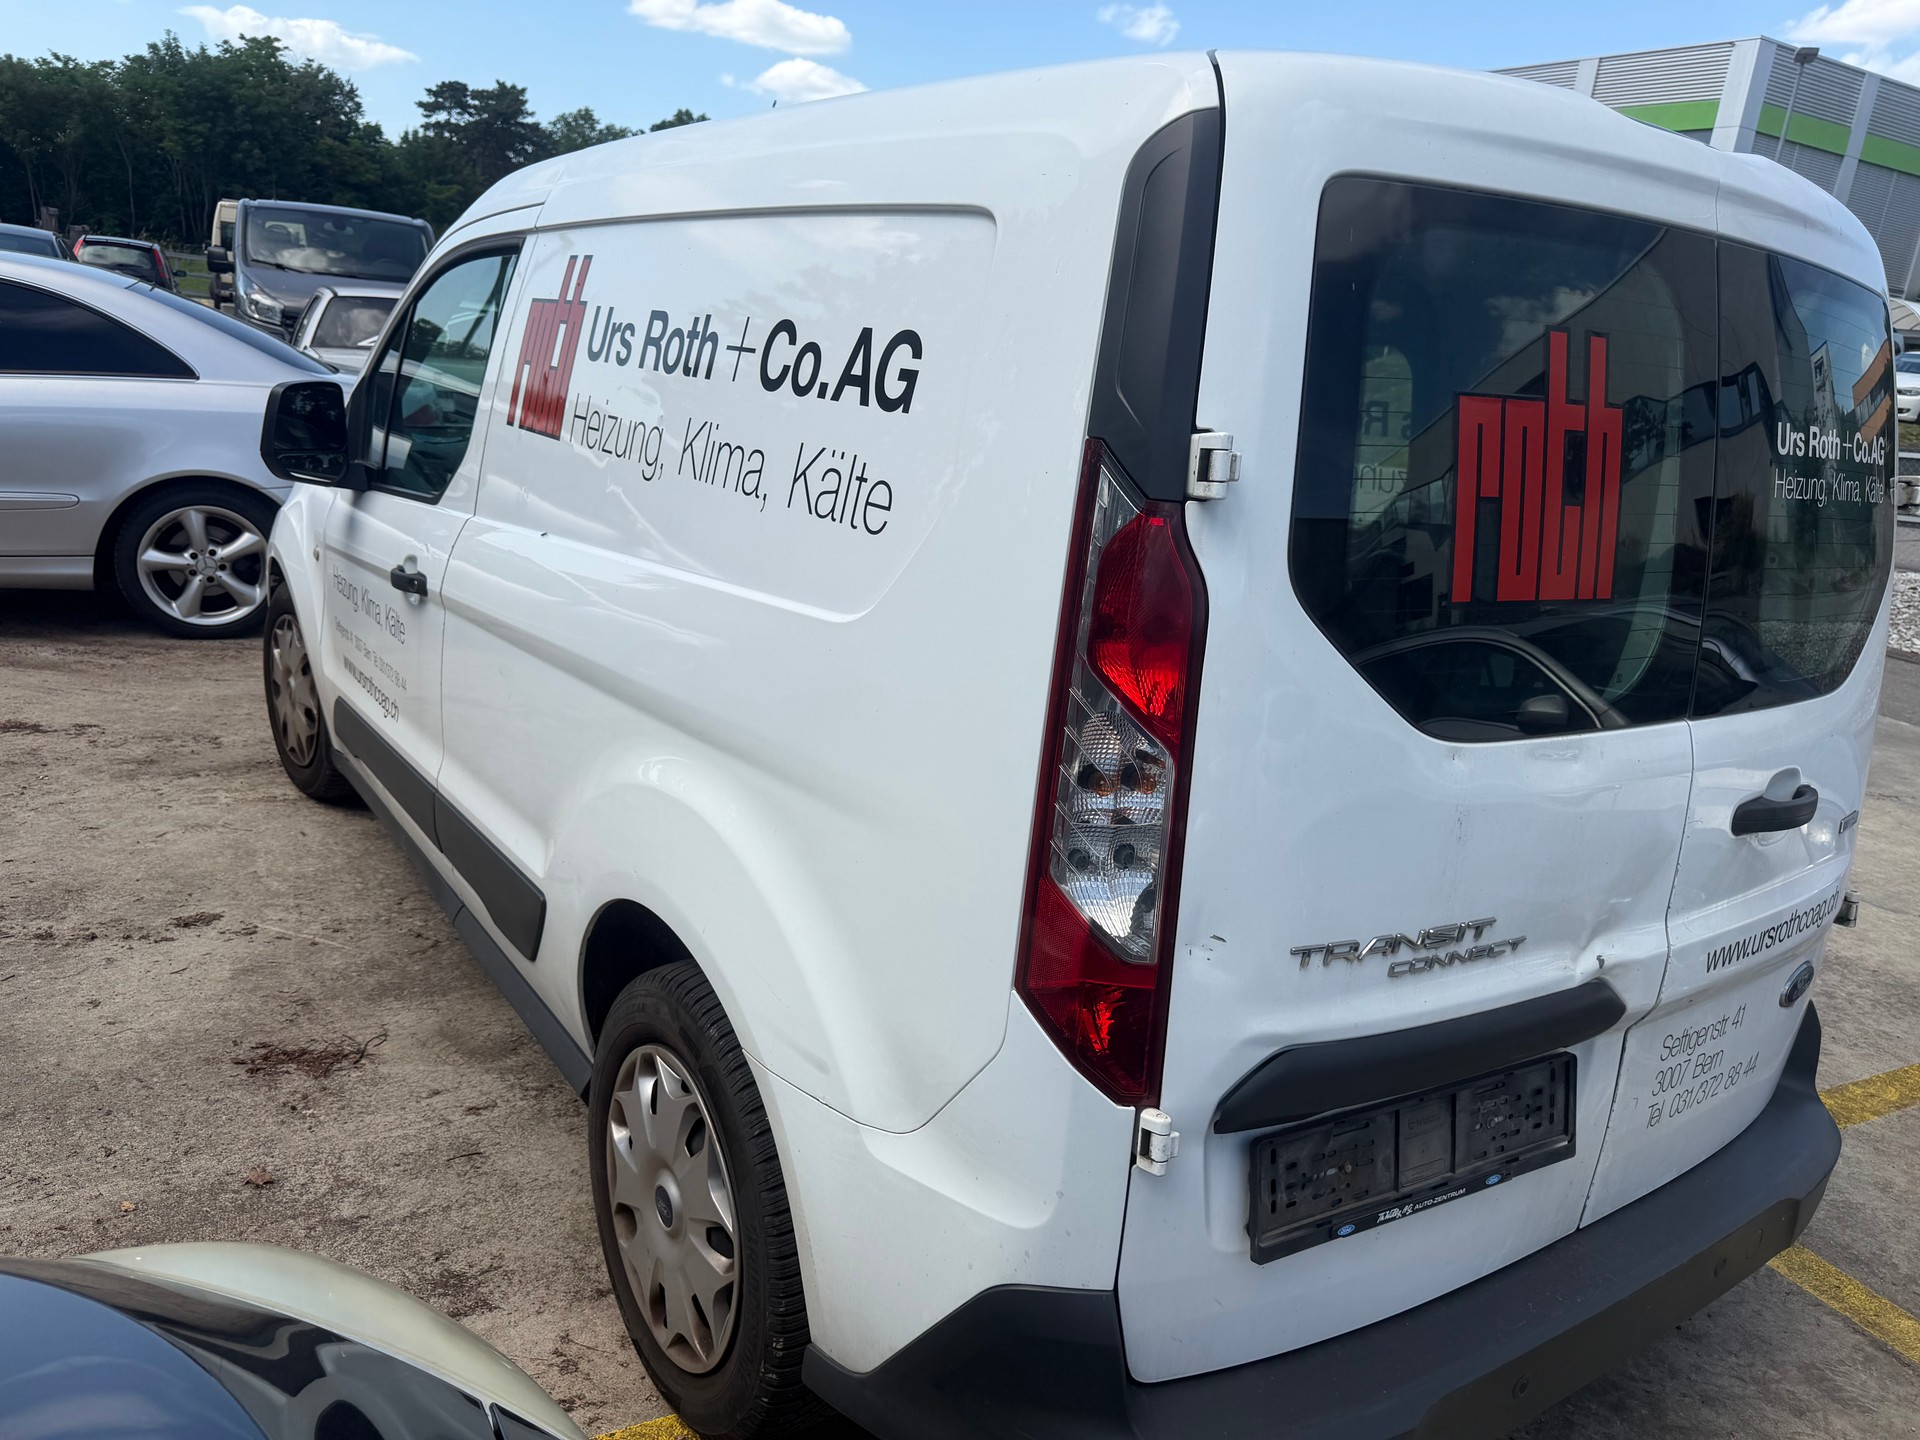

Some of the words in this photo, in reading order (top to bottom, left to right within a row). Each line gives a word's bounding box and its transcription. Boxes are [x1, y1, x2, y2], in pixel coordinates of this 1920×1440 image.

[587, 305, 635, 367] Urs
[1777, 421, 1805, 456] Urs
[569, 392, 664, 481] Heizung,
[677, 417, 767, 513] Klima,
[787, 442, 893, 535] Kälte
[1774, 468, 1828, 508] Heizung,
[1832, 472, 1862, 506] Klima,
[385, 603, 406, 645] Kälte
[1290, 916, 1497, 970] TRANSIT
[1706, 885, 1840, 974] www.ursrothcoag.ch
[1387, 935, 1527, 977] CONNECT
[1731, 1003, 1747, 1030] 41
[1651, 1060, 1692, 1097] 3007
[1692, 1050, 1724, 1080] Bern
[1668, 1072, 1724, 1118] 031/372
[1723, 1061, 1743, 1090] 88
[1743, 1051, 1760, 1078] 44
[1413, 1187, 1466, 1211] AUTO-ZENTRUM
